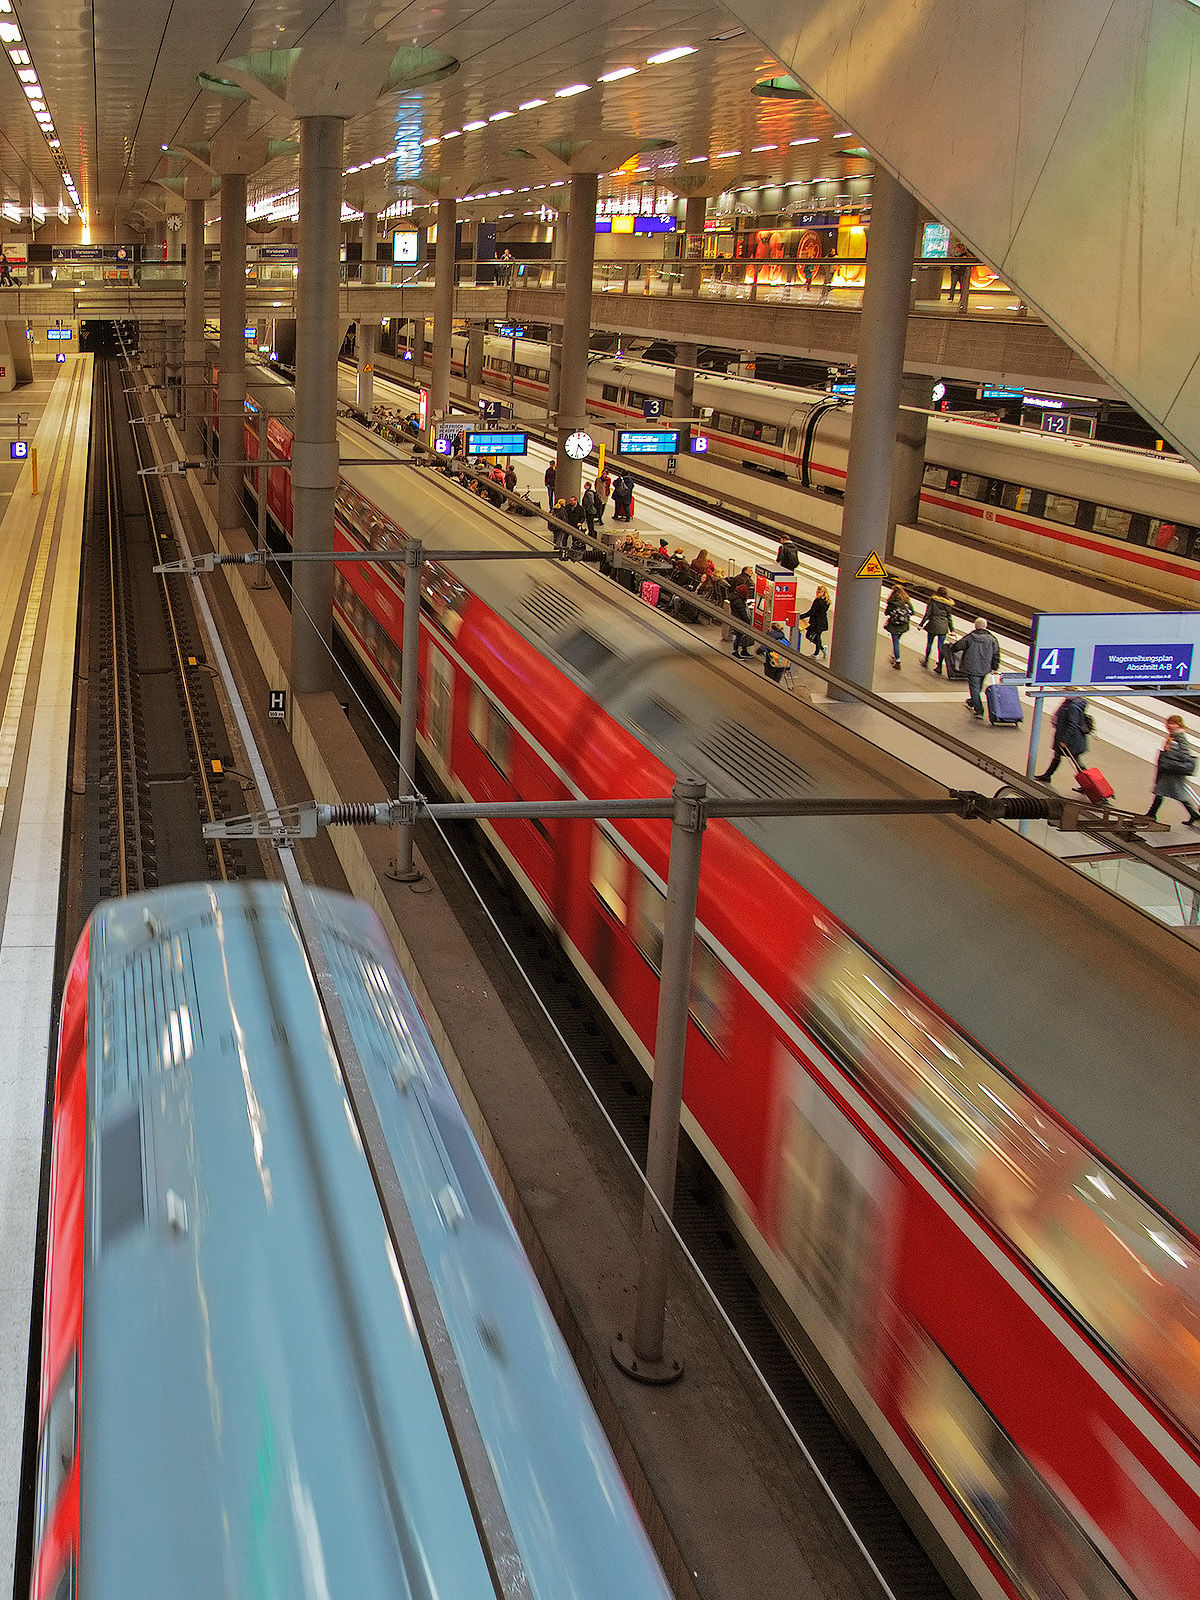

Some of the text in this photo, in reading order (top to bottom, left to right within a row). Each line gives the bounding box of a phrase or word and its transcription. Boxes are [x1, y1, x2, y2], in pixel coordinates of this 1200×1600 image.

[486, 402, 496, 416] 4
[649, 400, 660, 414] 3
[1047, 415, 1065, 433] 1-2
[15, 441, 27, 456] B
[435, 439, 448, 453] B
[695, 437, 708, 451] B
[1040, 648, 1061, 676] 4
[1108, 655, 1174, 664] Wagenreihungsplan
[1125, 663, 1173, 671] Abschnitt A-B
[271, 692, 284, 708] H
